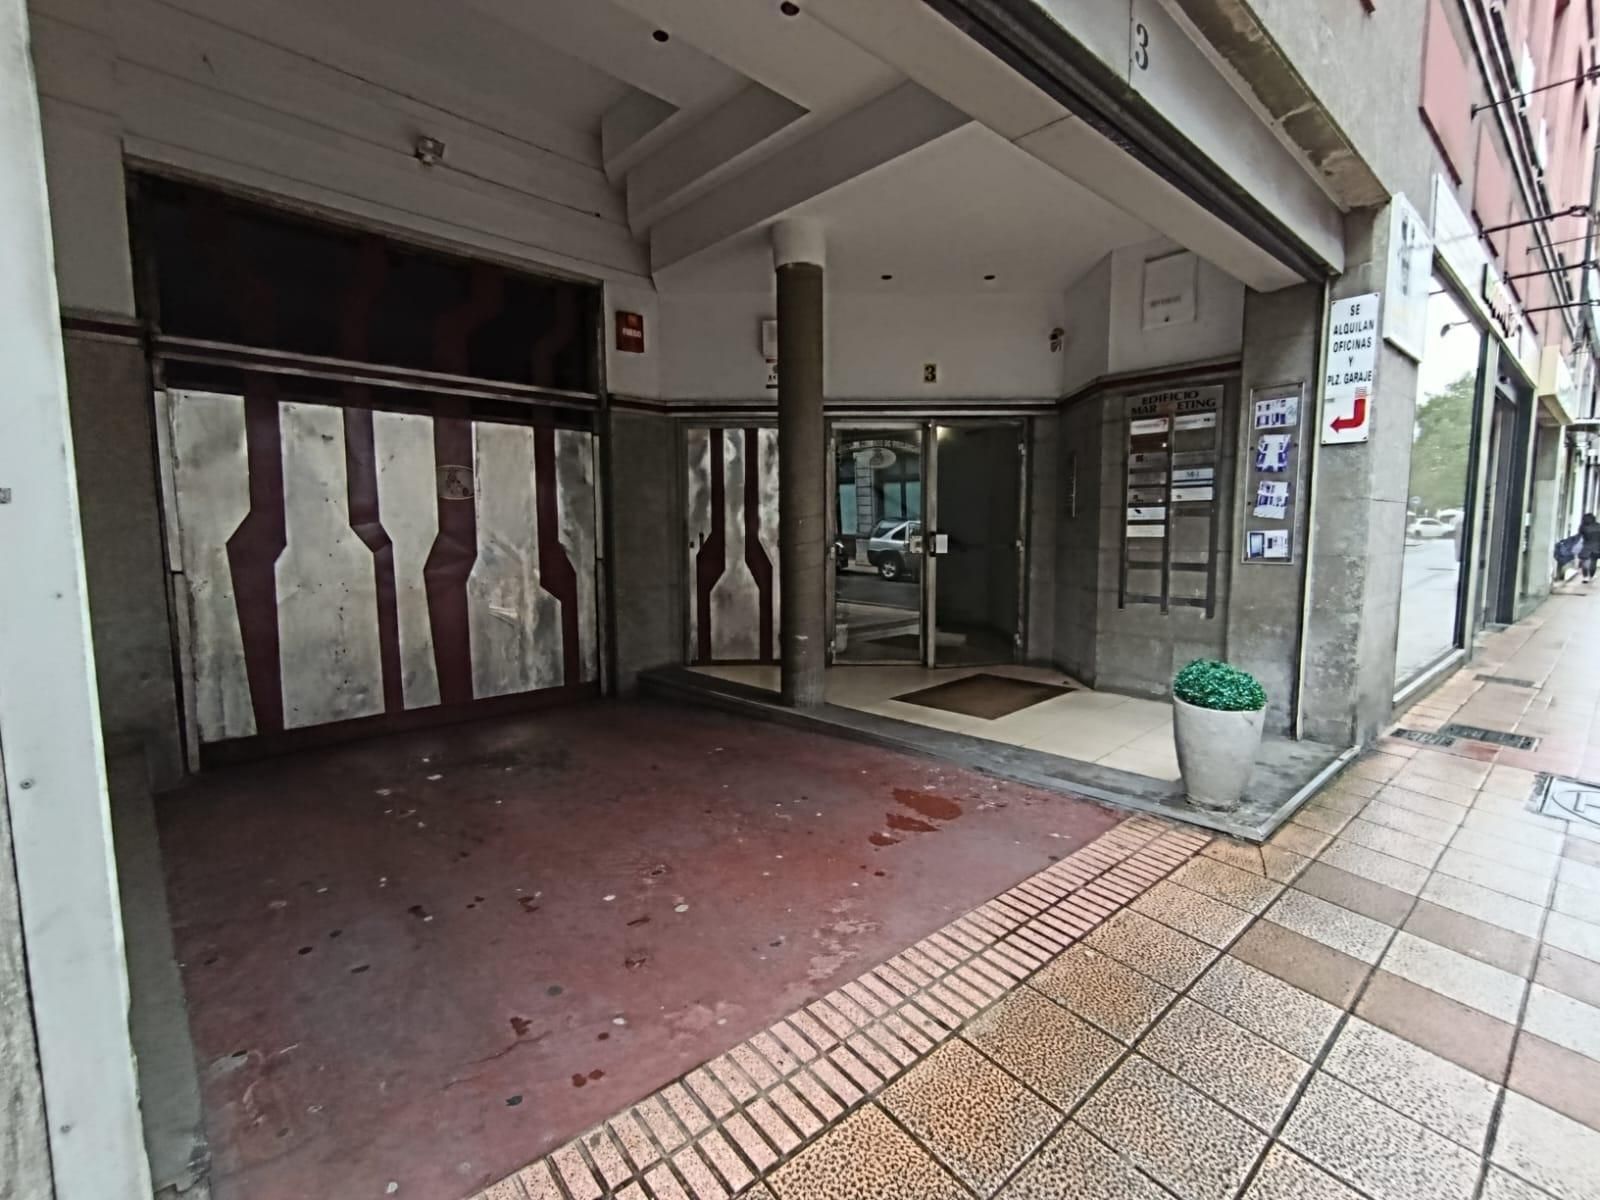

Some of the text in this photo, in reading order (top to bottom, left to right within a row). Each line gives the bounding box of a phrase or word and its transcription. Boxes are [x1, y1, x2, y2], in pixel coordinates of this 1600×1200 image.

[1135, 23, 1149, 71] 3
[1350, 304, 1360, 316] SE
[1333, 319, 1374, 335] ALQUILAN
[1333, 337, 1371, 353] OFICINAS
[1349, 356, 1353, 367] Y
[924, 364, 936, 382] 3
[1327, 370, 1372, 386] PLZ. GARAJE
[1142, 390, 1199, 405] EDIFICIO
[1131, 399, 1216, 414] MARETING
